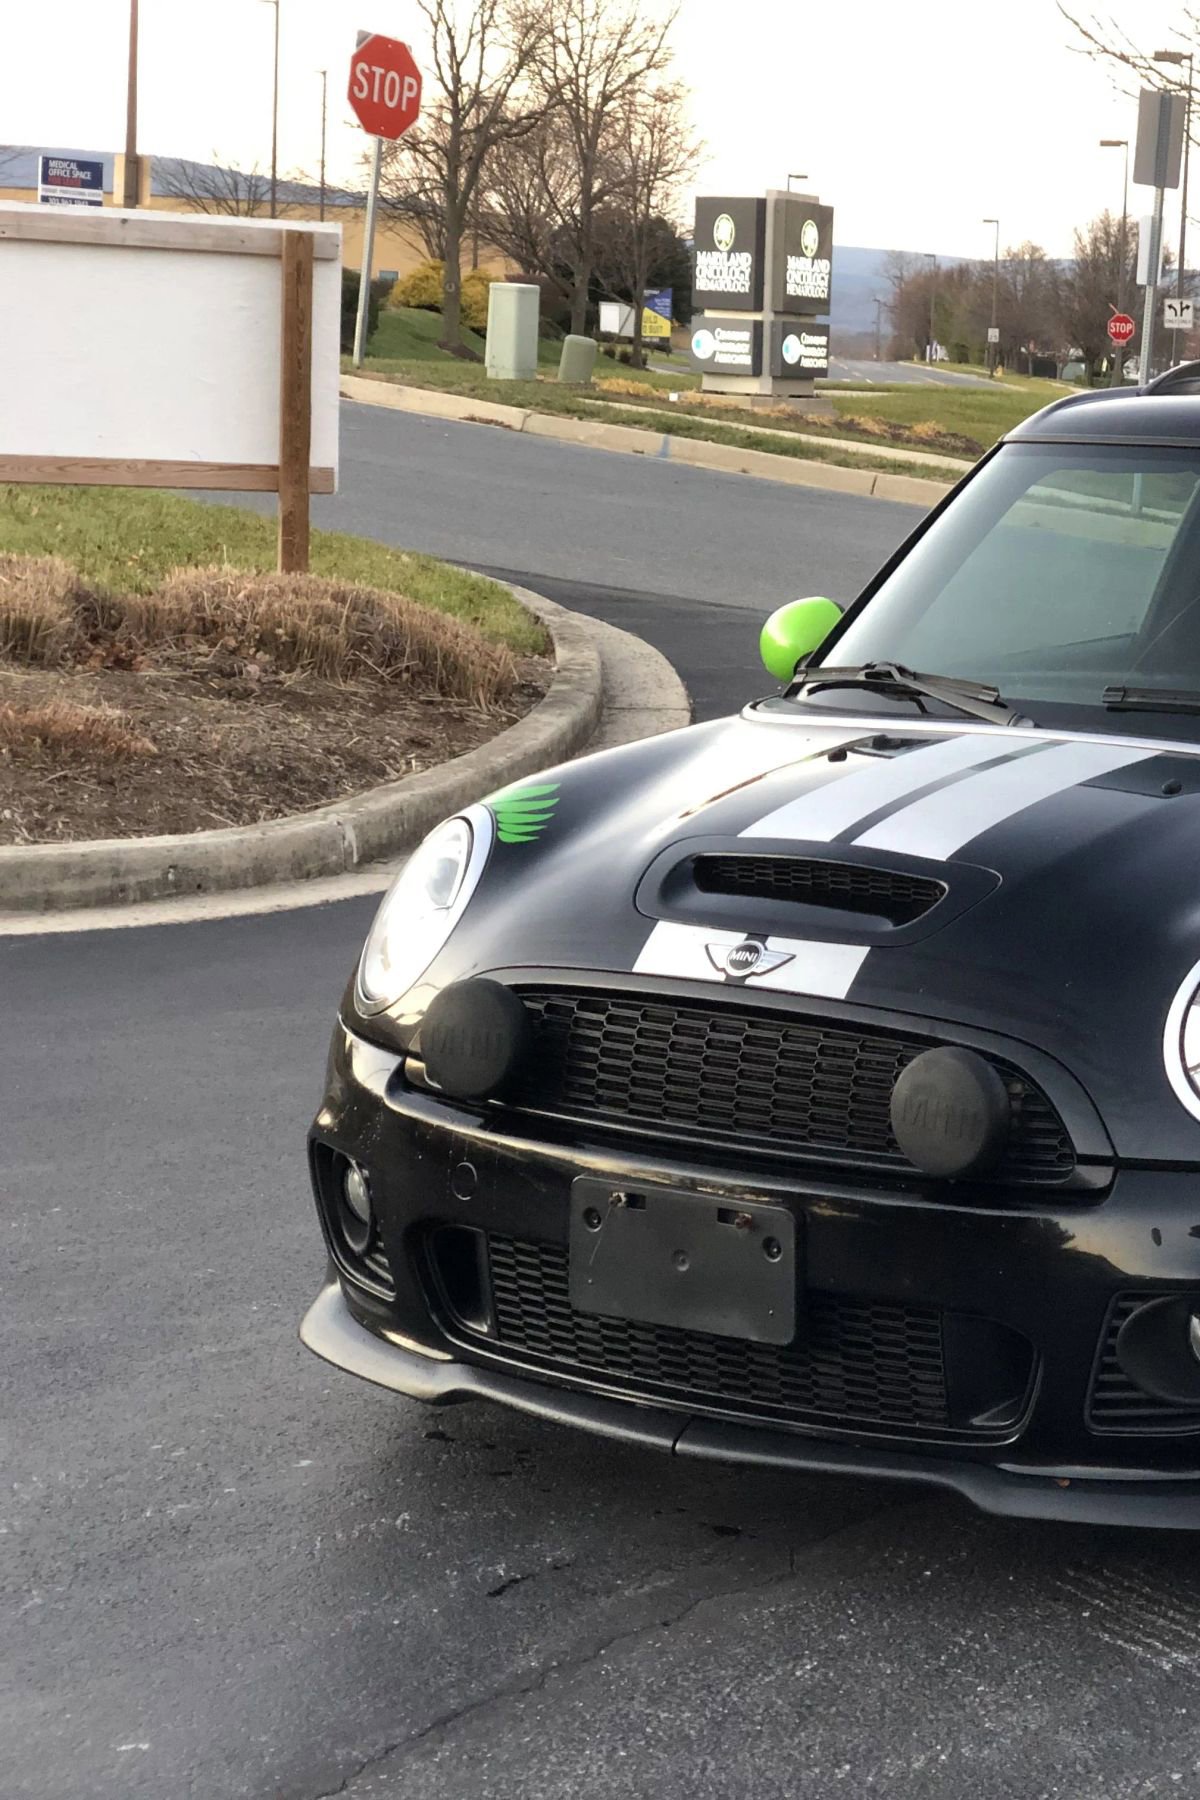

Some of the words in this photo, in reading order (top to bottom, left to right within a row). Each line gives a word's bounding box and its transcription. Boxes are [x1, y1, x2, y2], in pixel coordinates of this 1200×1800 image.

[353, 62, 418, 111] STOP
[49, 160, 78, 170] MEDICAL
[48, 168, 70, 178] OFFICE
[72, 170, 92, 180] SPACE
[696, 250, 752, 268] MARYLAND
[787, 255, 831, 273] MARYLAND
[695, 265, 751, 281] ONCOLOGY
[786, 270, 829, 287] ONCOLOGY
[695, 278, 751, 293] HEMATOLOGY
[786, 283, 829, 299] HEMATOLOGY
[1110, 322, 1133, 334] STOP
[730, 950, 758, 963] MINI
